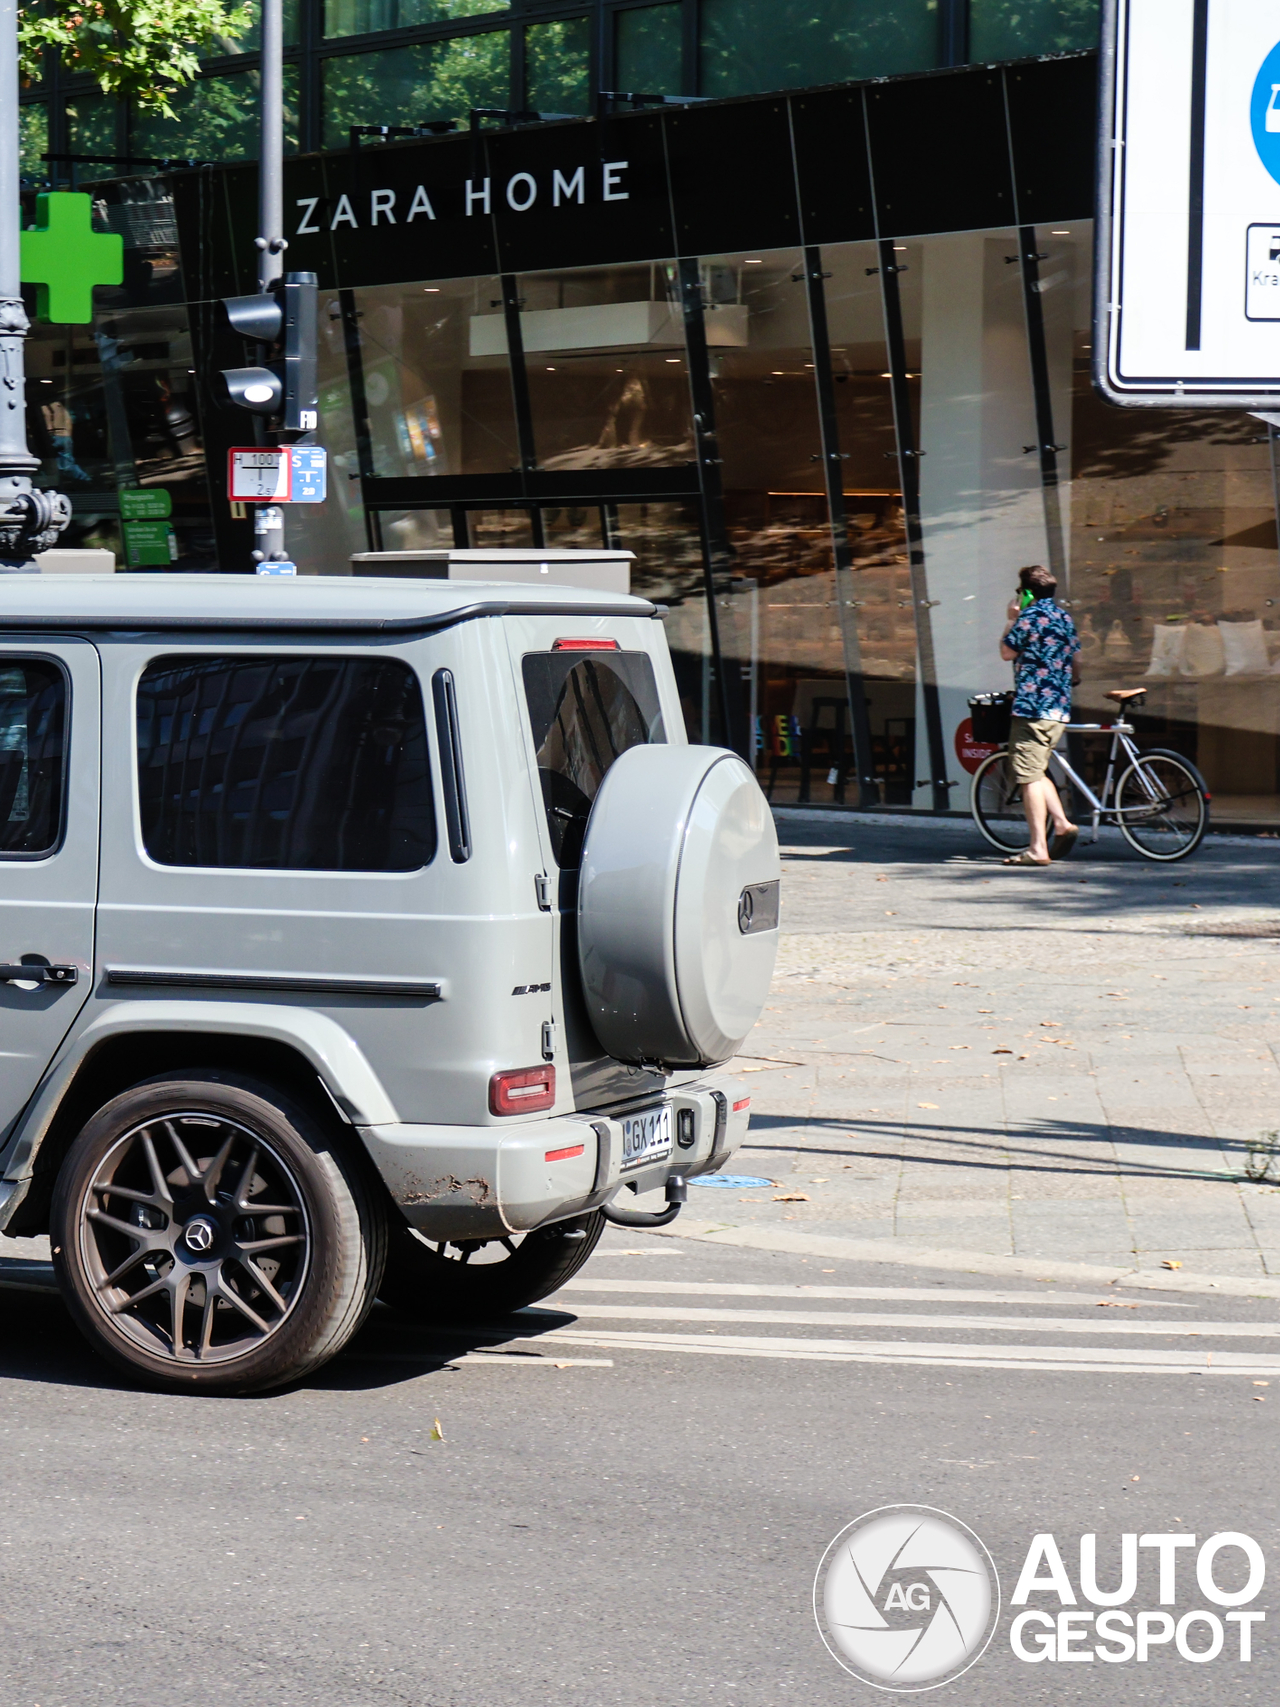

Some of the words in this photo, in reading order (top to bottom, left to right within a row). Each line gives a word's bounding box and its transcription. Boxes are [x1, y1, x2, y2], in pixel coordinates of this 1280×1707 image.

[295, 185, 437, 235] ZARA
[465, 161, 629, 217] HOME
[291, 455, 302, 468] S
